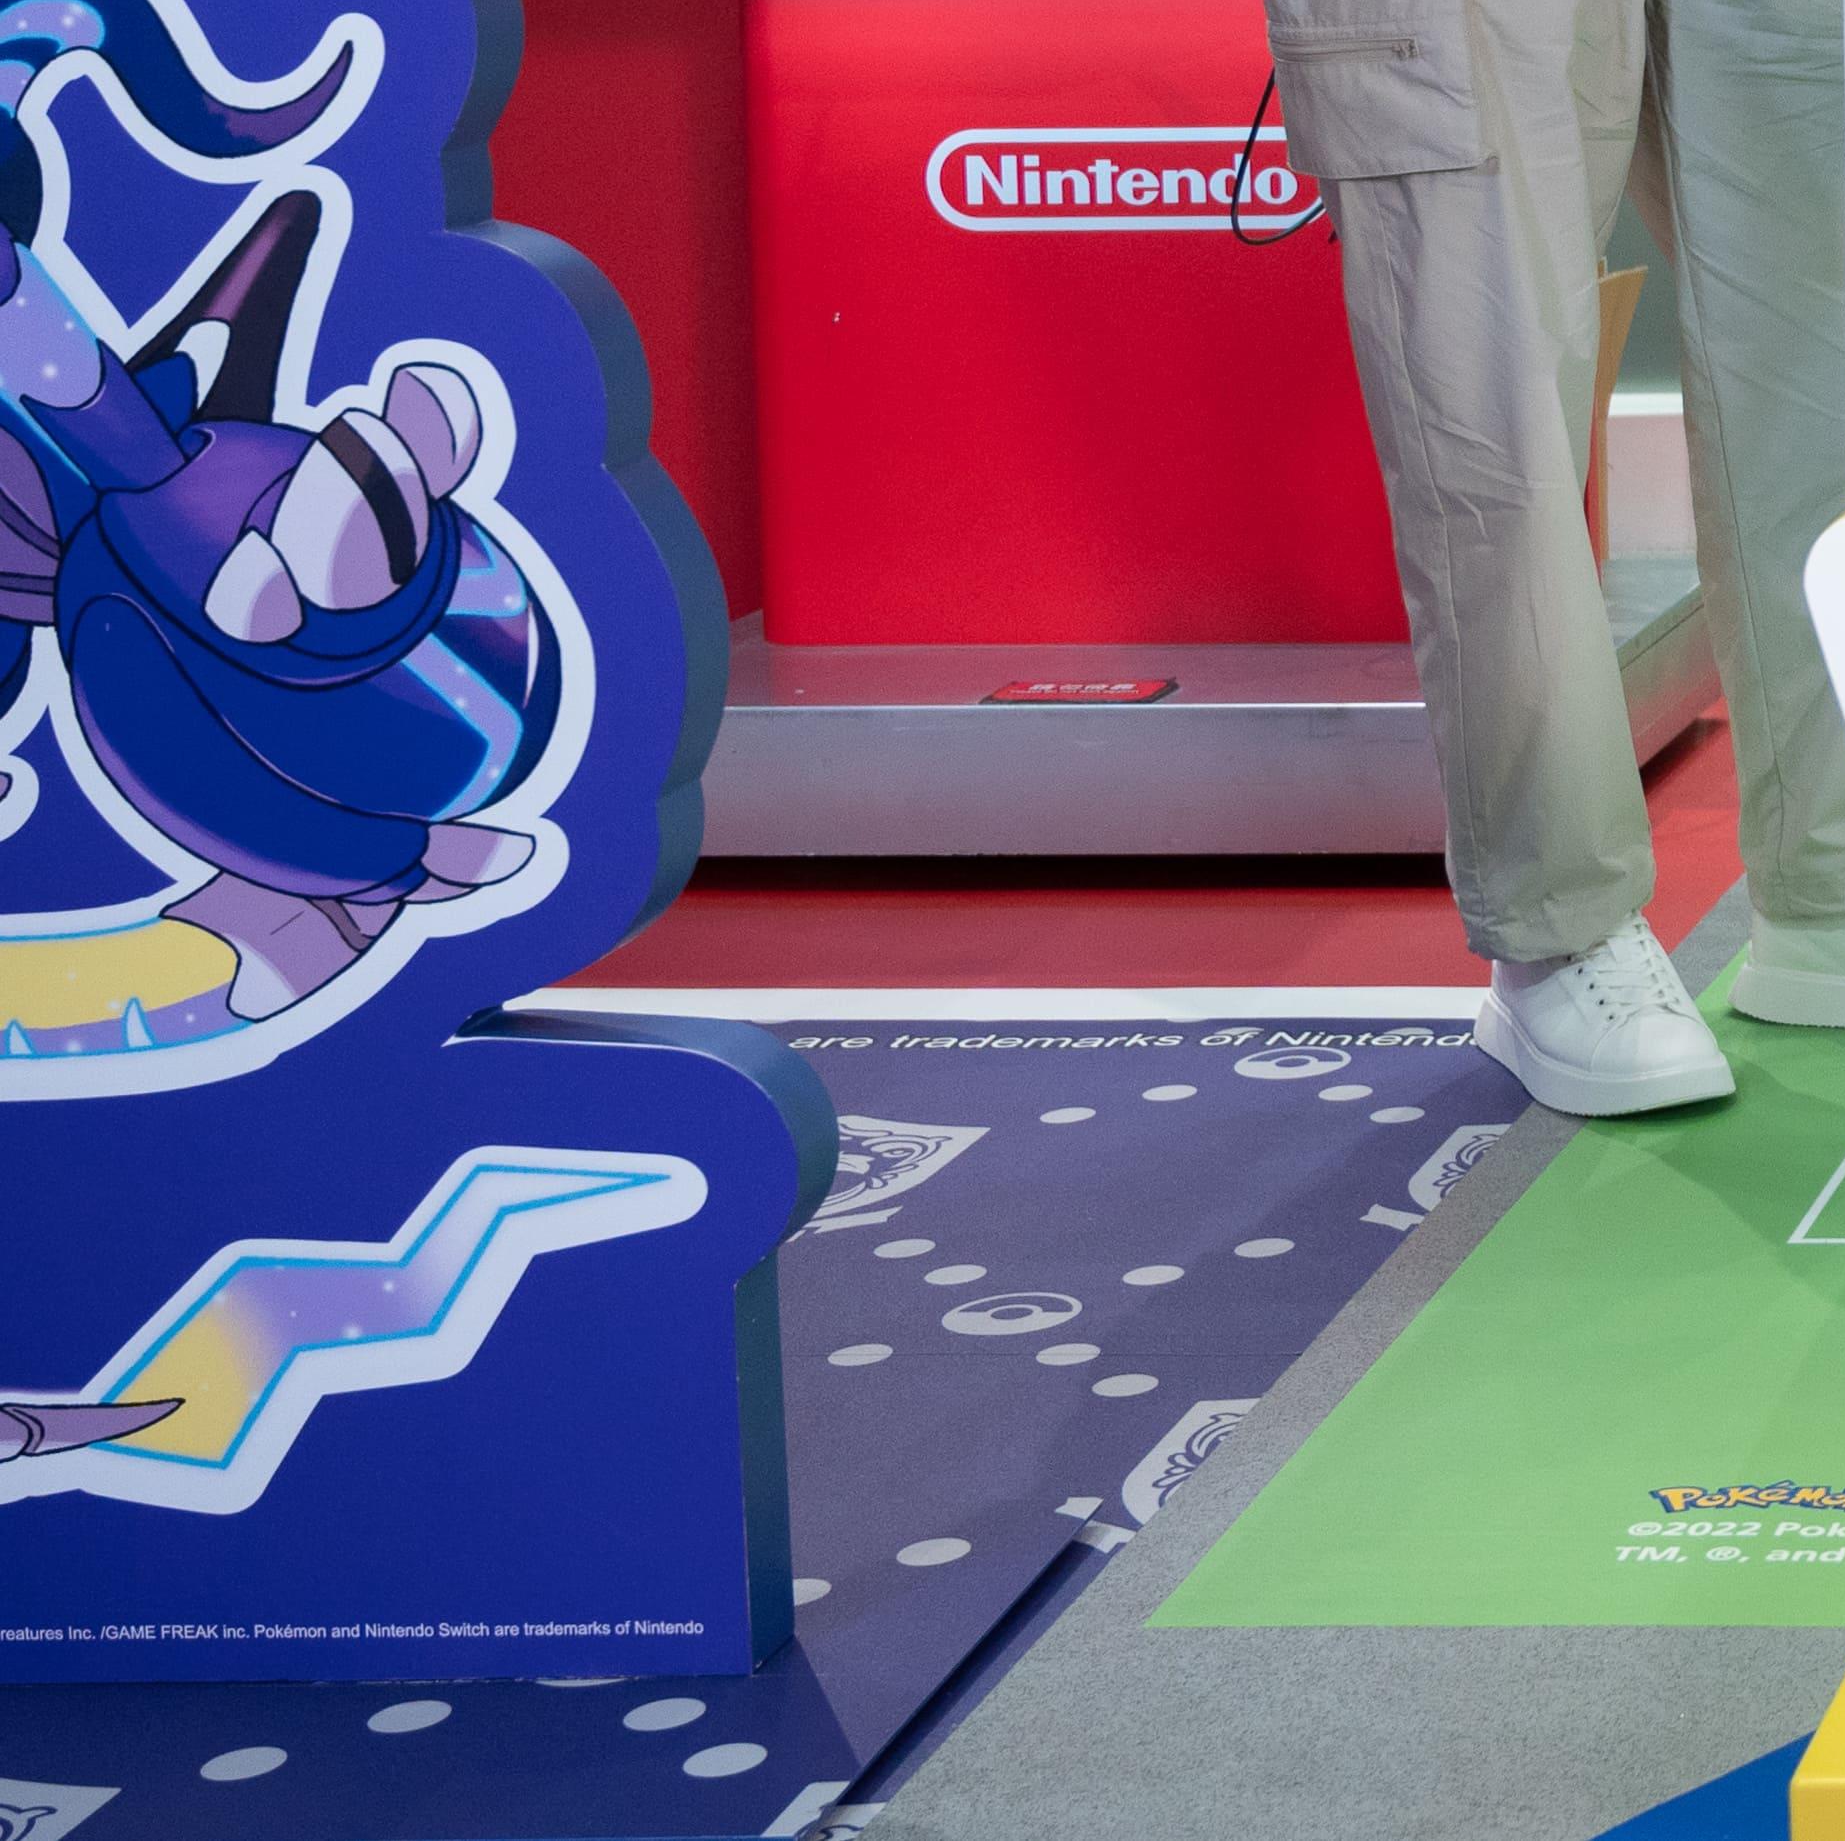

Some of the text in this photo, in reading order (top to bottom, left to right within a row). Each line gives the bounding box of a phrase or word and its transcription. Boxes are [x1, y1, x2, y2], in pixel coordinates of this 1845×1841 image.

[965, 153, 1298, 207] Nintendo
[788, 1027, 1477, 1050] are trademarks of Nintend
[1627, 1521, 1763, 1537] ©2022
[1614, 1545, 1689, 1564] TM,
[68, 1625, 97, 1641] Inc.
[100, 1624, 157, 1641] /GAME
[160, 1624, 219, 1640] FREAK
[222, 1623, 251, 1640] inc.
[253, 1622, 327, 1639] Pokémon
[330, 1623, 361, 1639] and
[365, 1622, 435, 1638] Nintendo
[438, 1621, 490, 1638] Switch
[495, 1624, 520, 1637] are
[523, 1620, 612, 1637] trademarks
[615, 1620, 631, 1636] of
[634, 1619, 705, 1636] Nintendo
